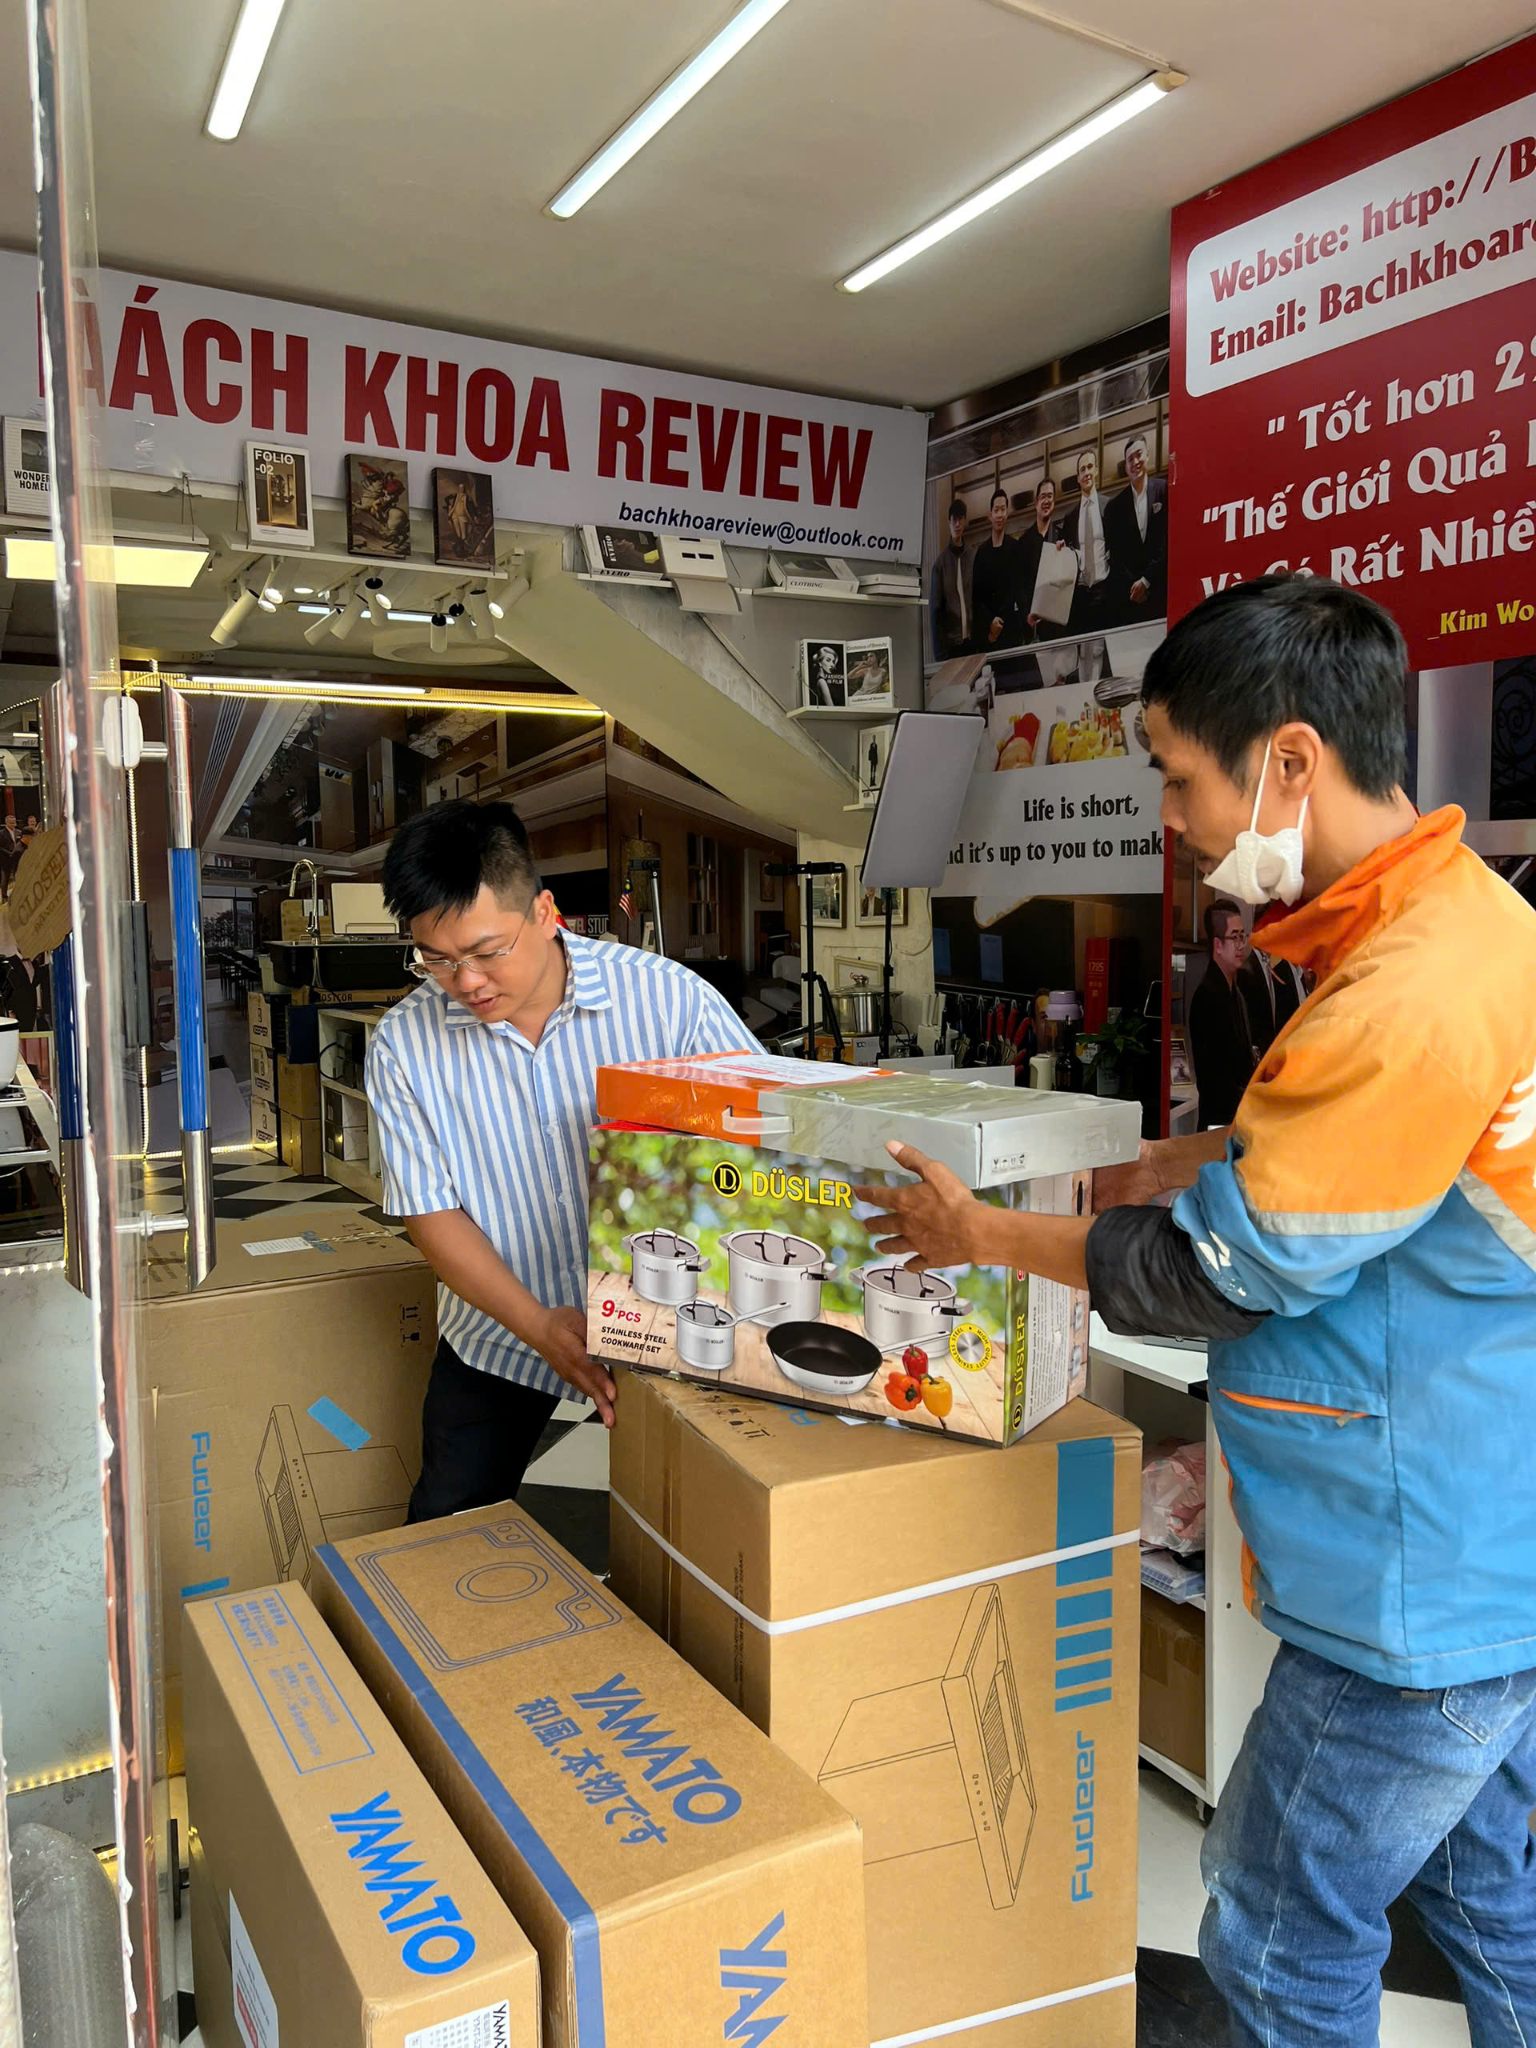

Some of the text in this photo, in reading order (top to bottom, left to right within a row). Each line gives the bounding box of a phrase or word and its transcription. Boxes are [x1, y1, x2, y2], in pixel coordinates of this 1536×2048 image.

[1209, 223, 1350, 303] Website:
[1209, 218, 1536, 366] Email: Bachkhoar
[344, 344, 570, 473] KHOA
[597, 387, 874, 510] REVIEW
[1297, 390, 1373, 450] Tốt
[1385, 369, 1475, 426] hơn
[1495, 337, 1536, 393] 2
[254, 449, 295, 465] FOLIO
[1202, 483, 1296, 543] "Thế
[1301, 459, 1392, 522] Giới
[1406, 429, 1507, 494] Quả
[618, 502, 904, 552] bachkhoareview@outlook.com
[1330, 533, 1405, 588] Rất
[1023, 793, 1140, 823] Life is short,
[1000, 847, 1021, 866] up
[1027, 841, 1046, 861] to
[1050, 841, 1087, 864] you
[1093, 838, 1114, 858] to
[751, 1167, 853, 1209] DÜSLER
[601, 1325, 668, 1345] STAINLESS STEEL
[601, 1336, 662, 1355] COOKWARE SET
[1014, 1312, 1026, 1397] DÜSLER
[191, 1431, 212, 1553] Fudeer
[514, 1695, 668, 1845] 和風、本物です
[571, 1672, 742, 1825] YAMATO
[1071, 1729, 1096, 1903] Fudeer
[329, 1791, 476, 1976] YAMATO
